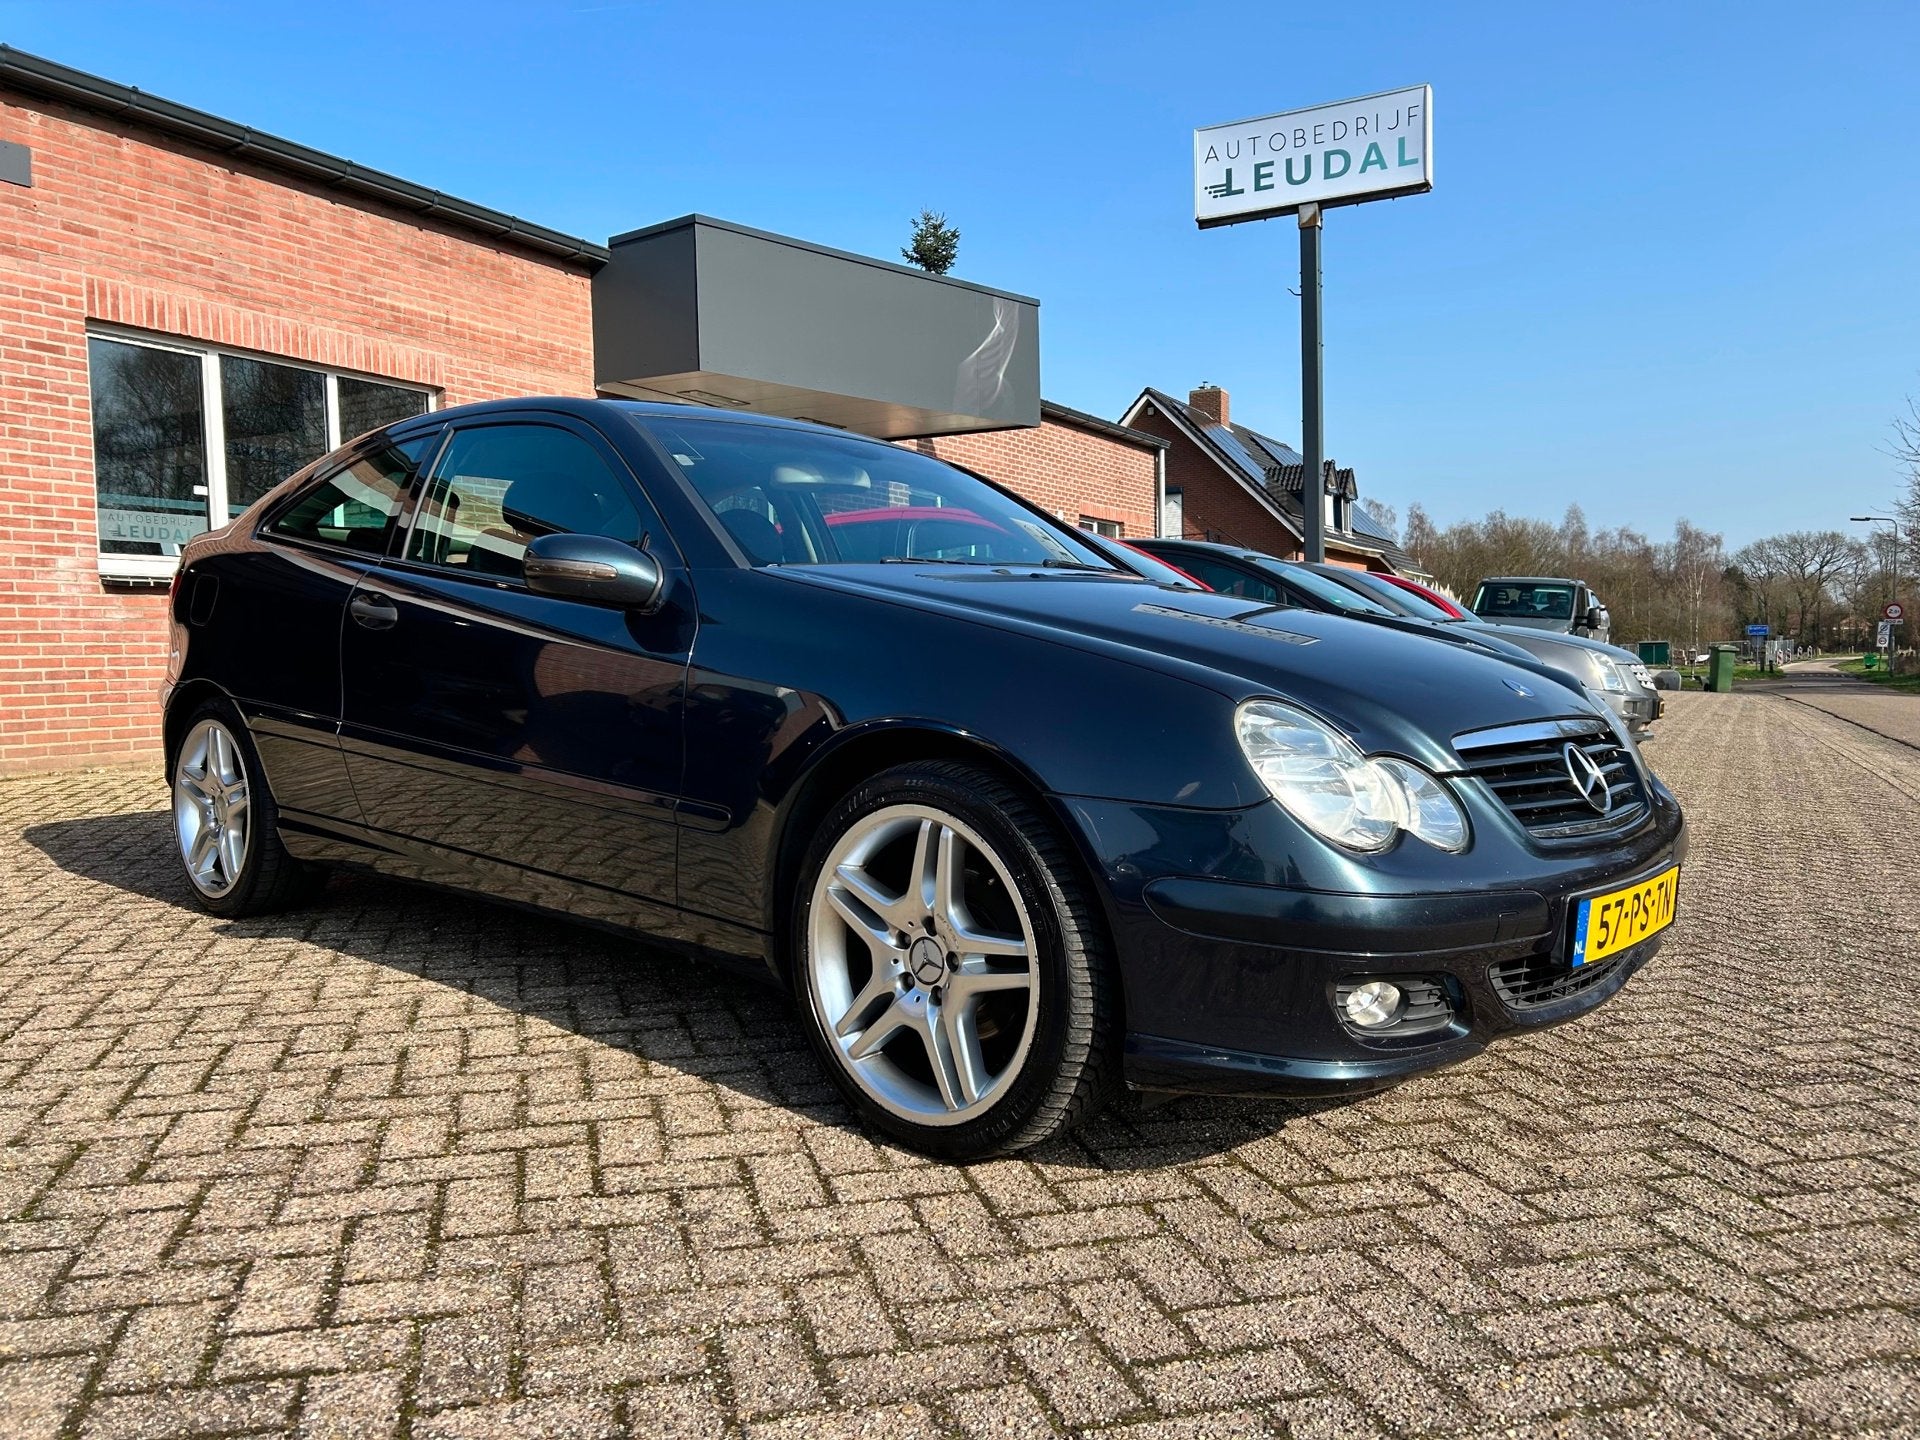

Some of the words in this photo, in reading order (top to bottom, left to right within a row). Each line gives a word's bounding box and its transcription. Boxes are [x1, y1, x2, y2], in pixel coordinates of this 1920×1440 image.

[1204, 105, 1420, 164] AUTOBEDRIJF
[1224, 136, 1419, 197] LEUDAL
[107, 513, 195, 527] AUTOBEDRIJF
[1597, 876, 1673, 950] 57-PS-TN
[1574, 941, 1584, 956] NL
